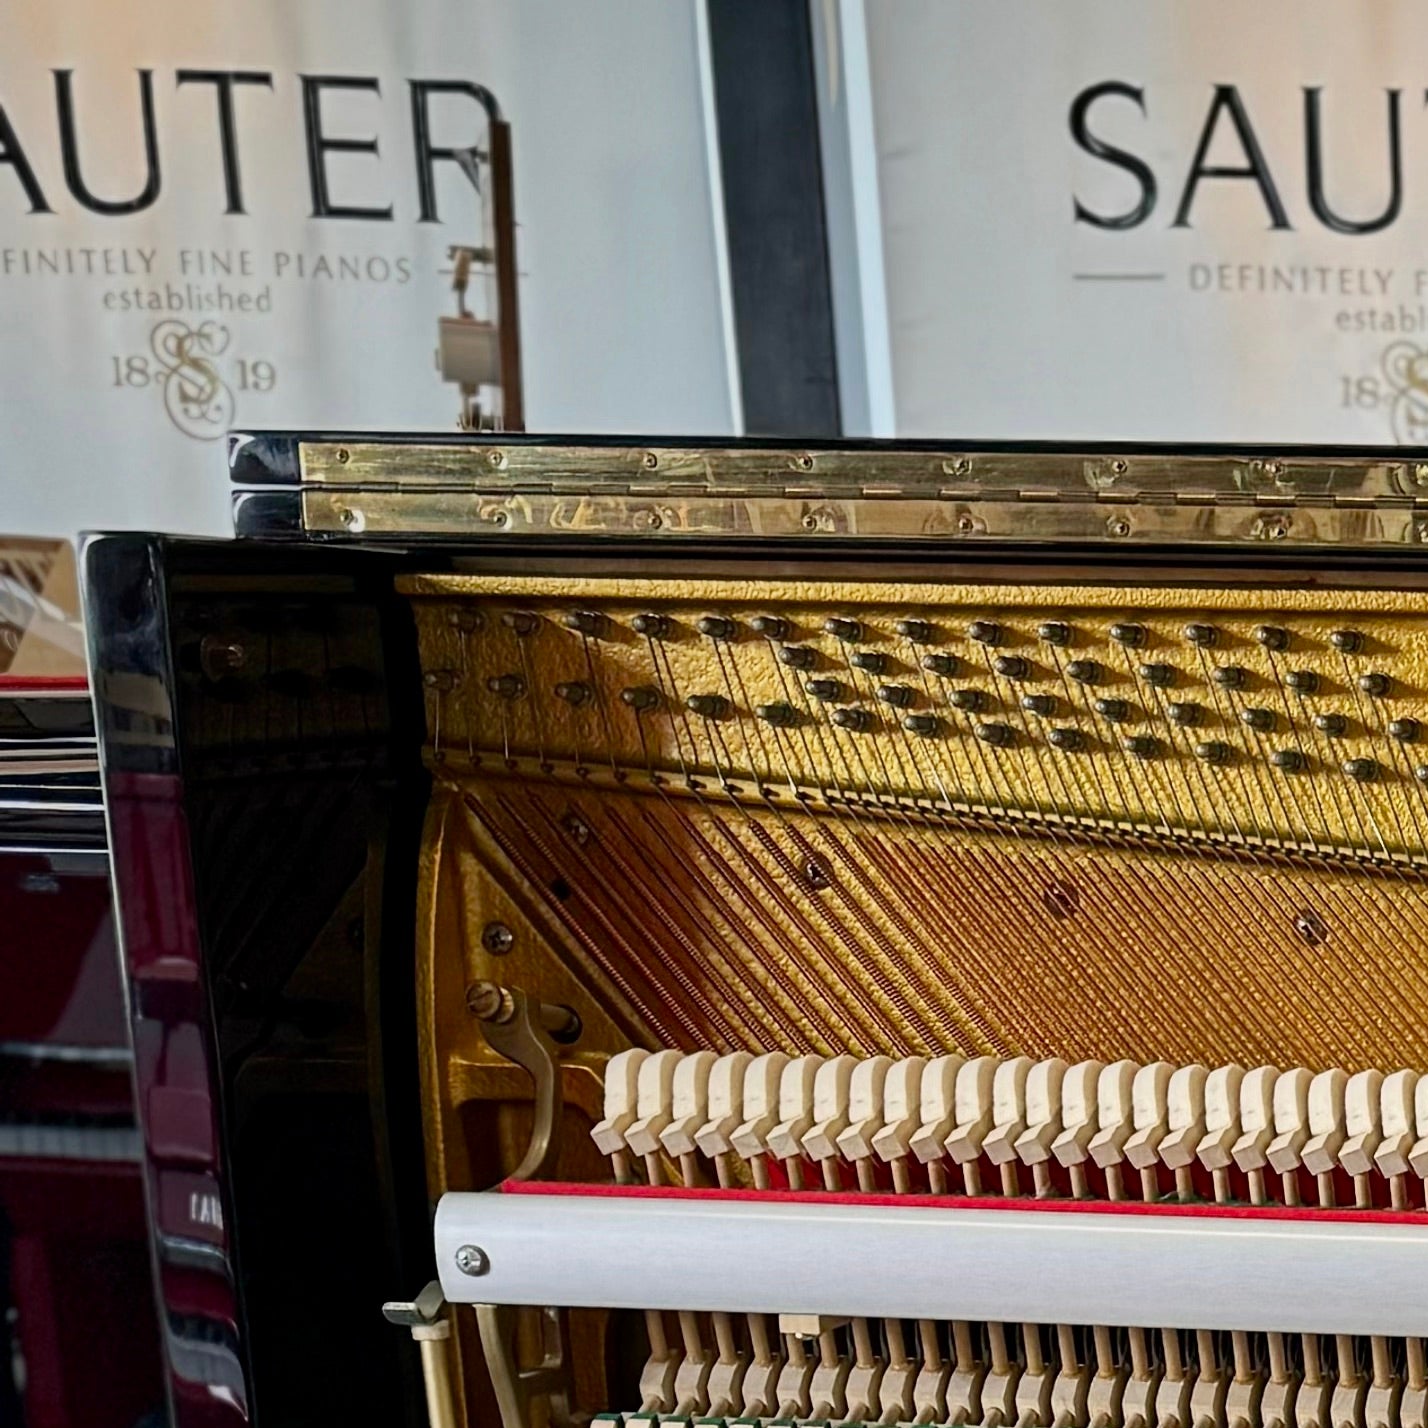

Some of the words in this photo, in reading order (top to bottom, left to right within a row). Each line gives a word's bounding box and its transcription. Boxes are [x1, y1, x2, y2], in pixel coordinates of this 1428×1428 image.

[180, 250, 254, 277] FINE
[275, 251, 412, 284] PIANOS
[1188, 263, 1395, 297] DEFINITELY
[102, 284, 273, 313] established
[111, 355, 151, 388] 18
[236, 359, 277, 392] 19
